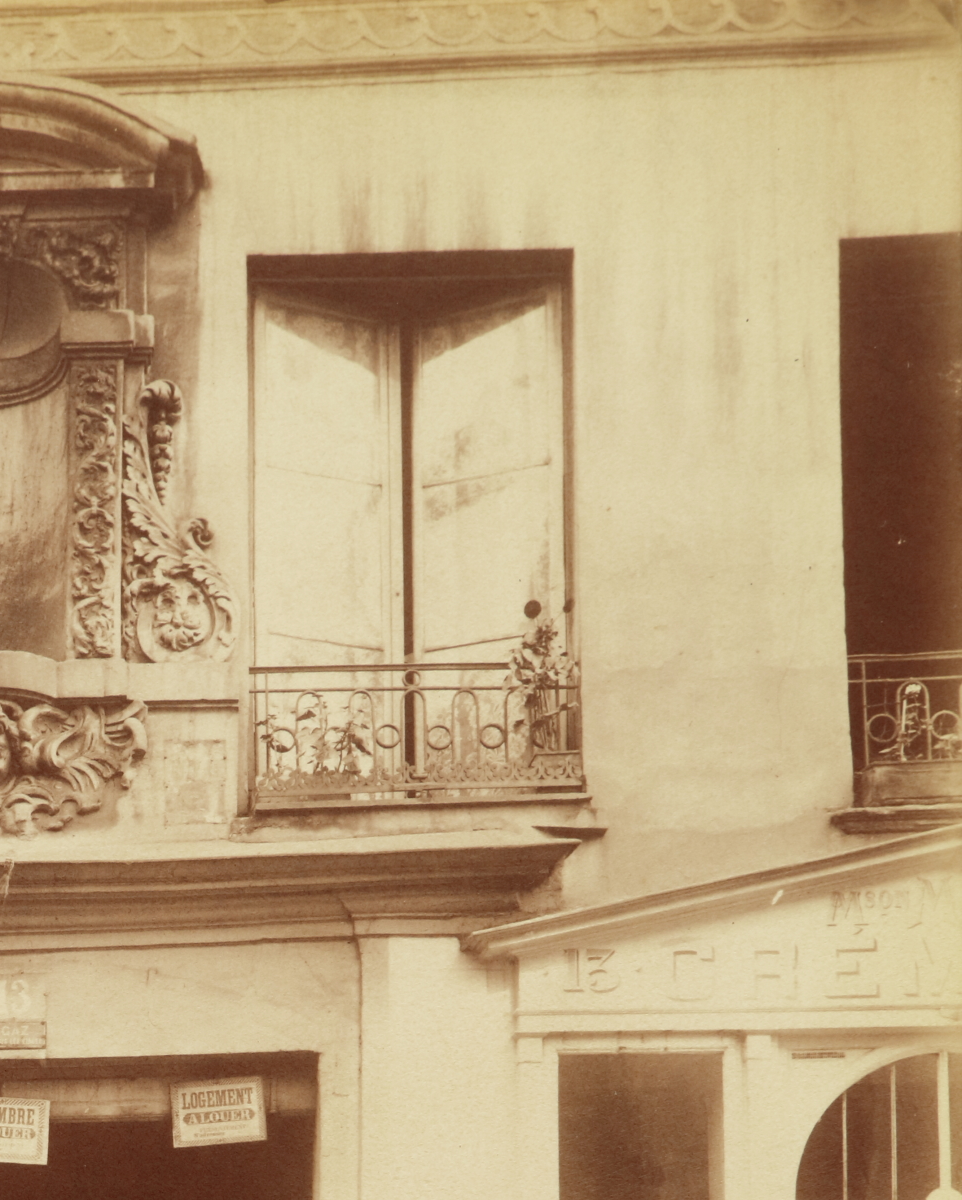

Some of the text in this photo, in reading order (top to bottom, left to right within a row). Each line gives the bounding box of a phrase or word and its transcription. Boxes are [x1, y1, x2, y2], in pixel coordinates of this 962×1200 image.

[563, 947, 621, 994] 13
[1, 1025, 29, 1036] GAZ
[181, 1087, 253, 1110] LOGEMENT
